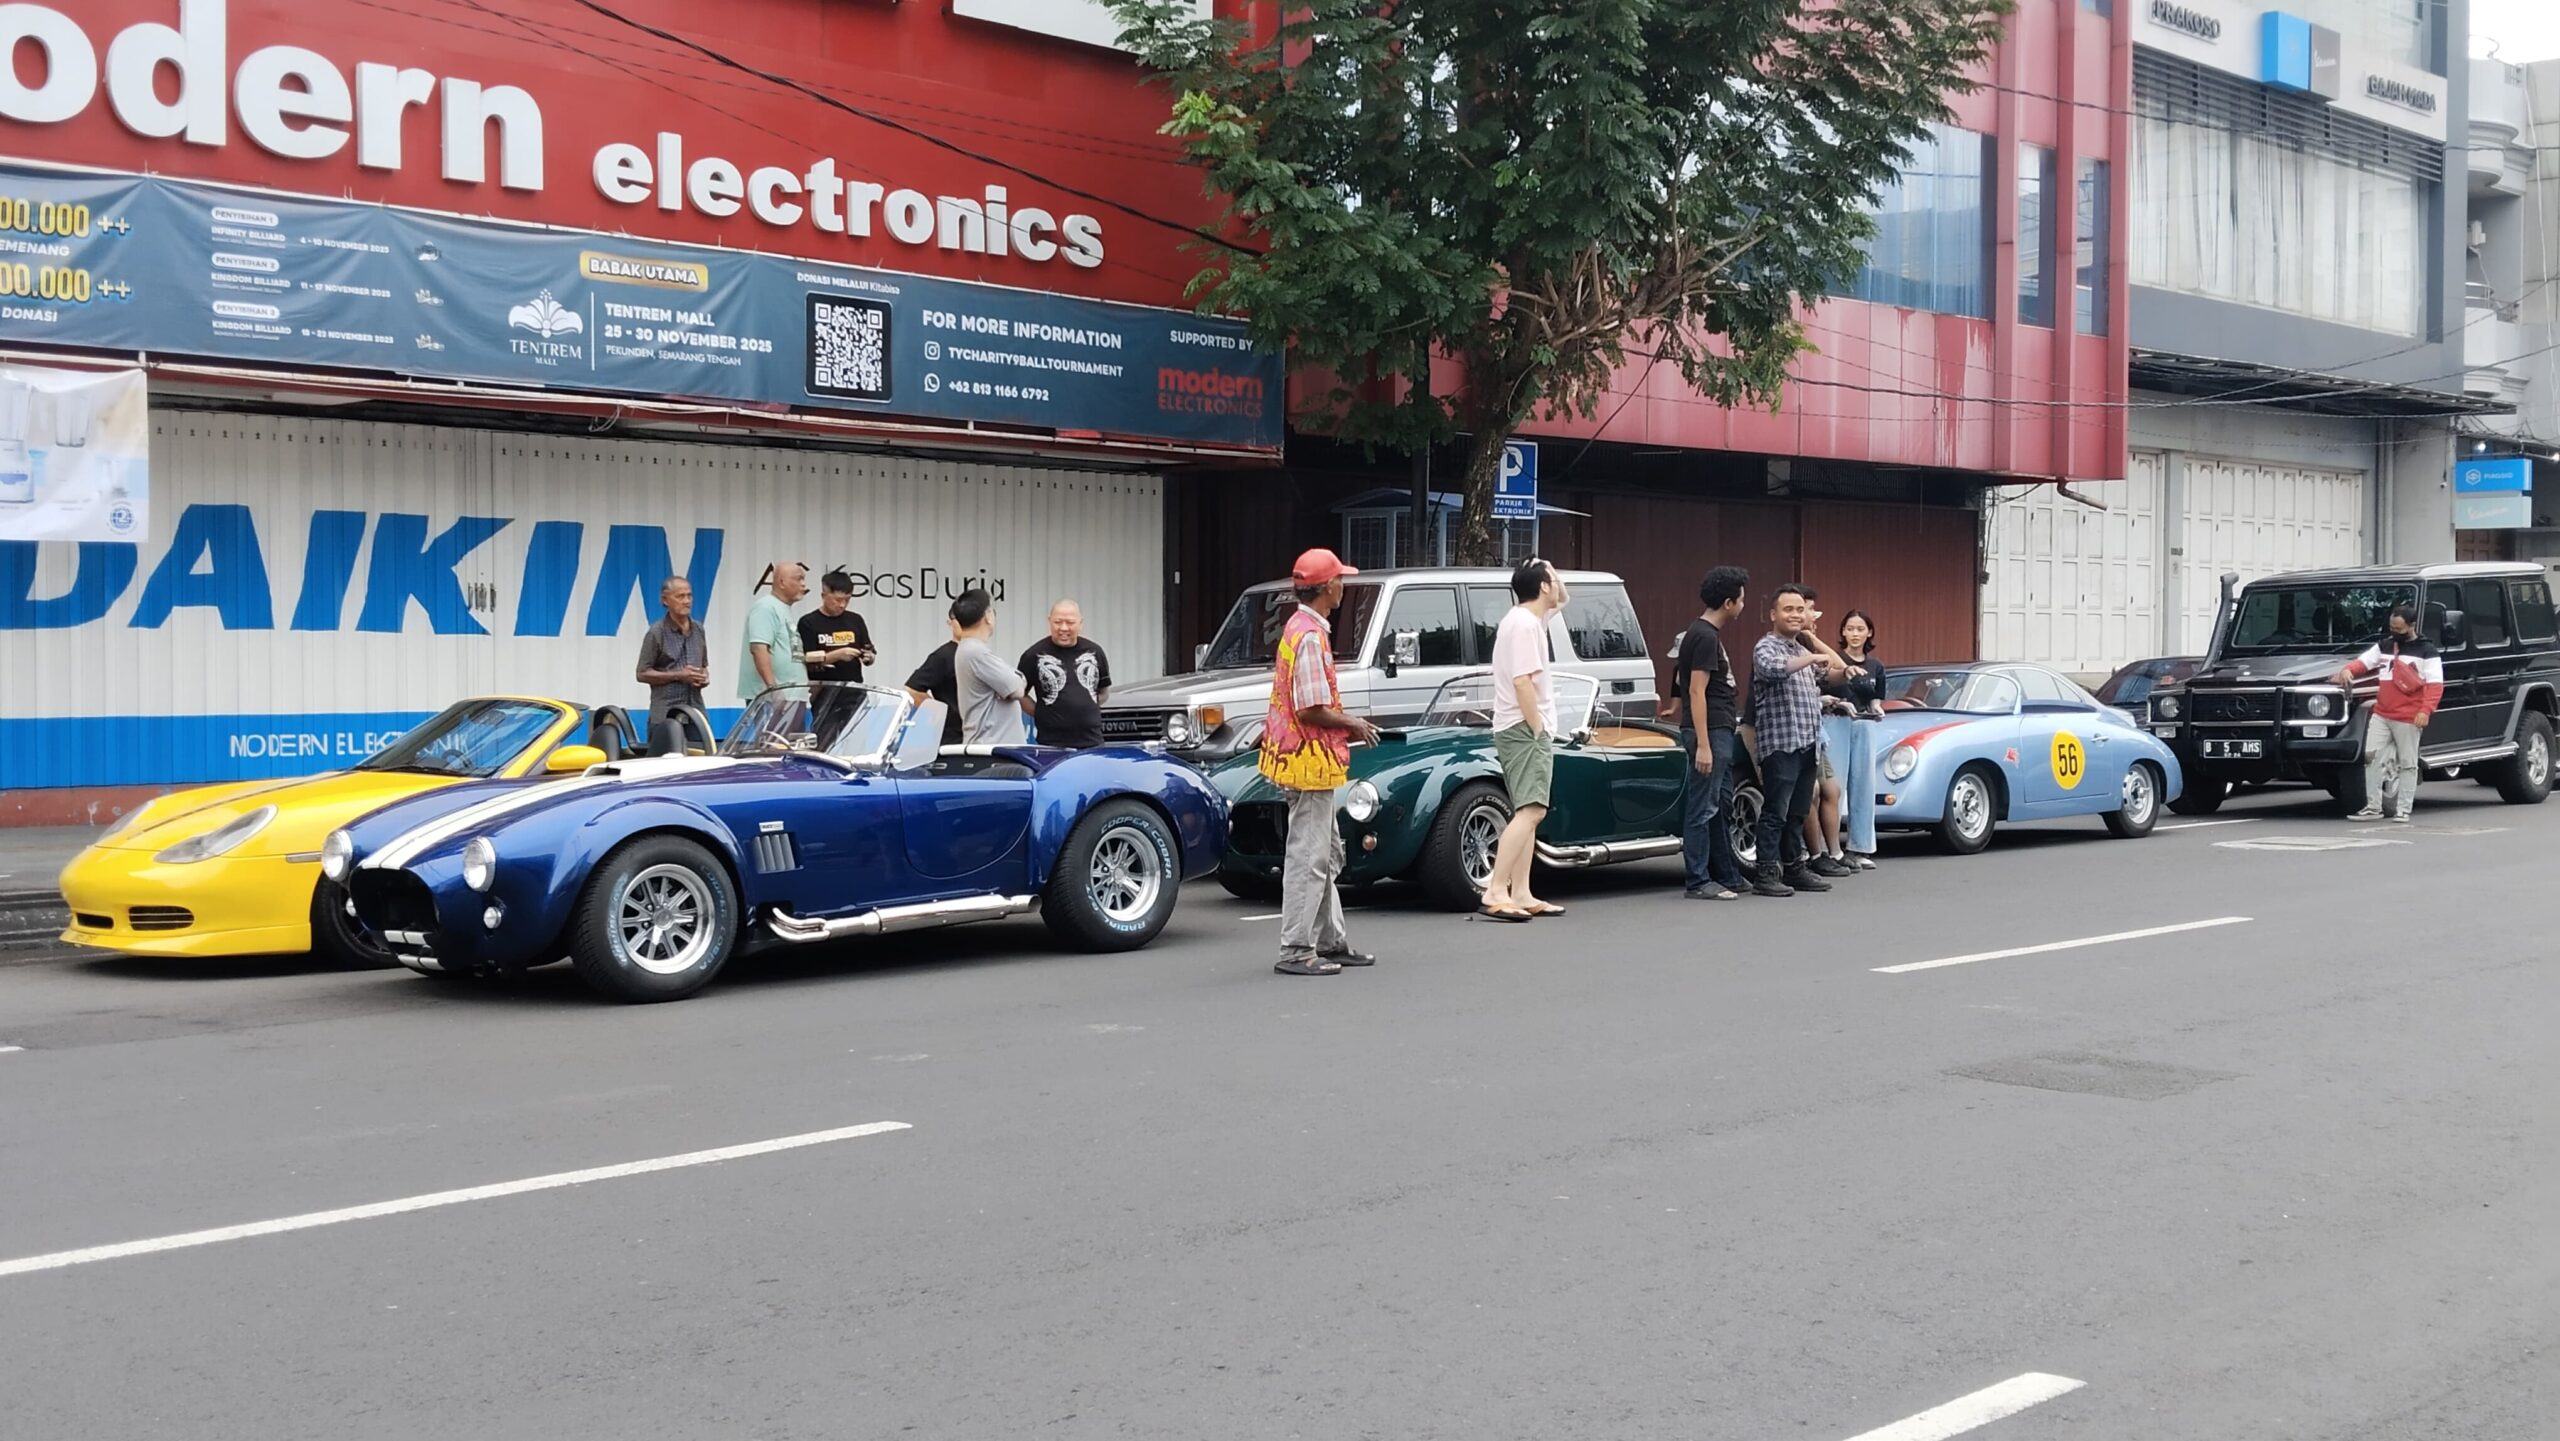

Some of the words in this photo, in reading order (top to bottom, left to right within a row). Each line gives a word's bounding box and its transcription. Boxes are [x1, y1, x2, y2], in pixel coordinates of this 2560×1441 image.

[2152, 0, 2221, 39] PRAKOSO
[593, 131, 1104, 270] electronics
[324, 239, 369, 251] NOVEMBER
[211, 272, 253, 284] KINGDOM
[253, 276, 291, 288] BILLIARD
[590, 259, 642, 277] BABAK
[644, 264, 699, 285] UTAMA
[796, 272, 830, 286] DONASI
[832, 277, 868, 290] MELALUI
[325, 284, 370, 296] NOVEMBER
[1, 306, 59, 322] DONASI
[604, 302, 672, 323] TENTREM
[676, 309, 715, 327] MALL
[212, 320, 254, 331] KINGDOM
[254, 324, 292, 335] BILLIARD
[328, 331, 373, 342] NOVEMBER
[604, 324, 622, 338] 25
[635, 326, 651, 341] 30
[657, 329, 737, 349] NOVEMBER
[740, 337, 773, 352] 2025
[922, 310, 957, 329] FOR
[961, 315, 1009, 336] MORE
[1013, 321, 1122, 349] INFORMATION
[509, 339, 582, 359] TENTREM
[1170, 329, 1236, 349] SUPPORTED
[1238, 338, 1253, 351] BY
[535, 356, 558, 366] MALL
[606, 345, 656, 360] PEKUNDEN,
[658, 347, 705, 364] SEMARANG
[707, 352, 741, 366] TENGAH
[948, 346, 1124, 377] TYCHARITY9BALLTOURNAMENT
[949, 380, 970, 394] +62
[972, 382, 992, 396] 813
[994, 384, 1019, 398] 1166
[1021, 387, 1049, 401] 6792
[1157, 367, 1263, 400] modern
[1157, 393, 1263, 418] ELECTRONICS
[1499, 445, 1524, 493] P
[1494, 499, 1523, 507] PARKIR
[0, 503, 724, 637] DAIKIN
[753, 561, 810, 596] A
[1101, 720, 1138, 732] TOYOTA
[230, 734, 328, 758] MODERN
[2205, 742, 2212, 753] B
[2223, 742, 2230, 753] 5
[2057, 743, 2078, 776] 56
[1100, 816, 1149, 834] COOPER
[1151, 830, 1173, 879] COBRA
[1103, 917, 1146, 932] RADIAL
